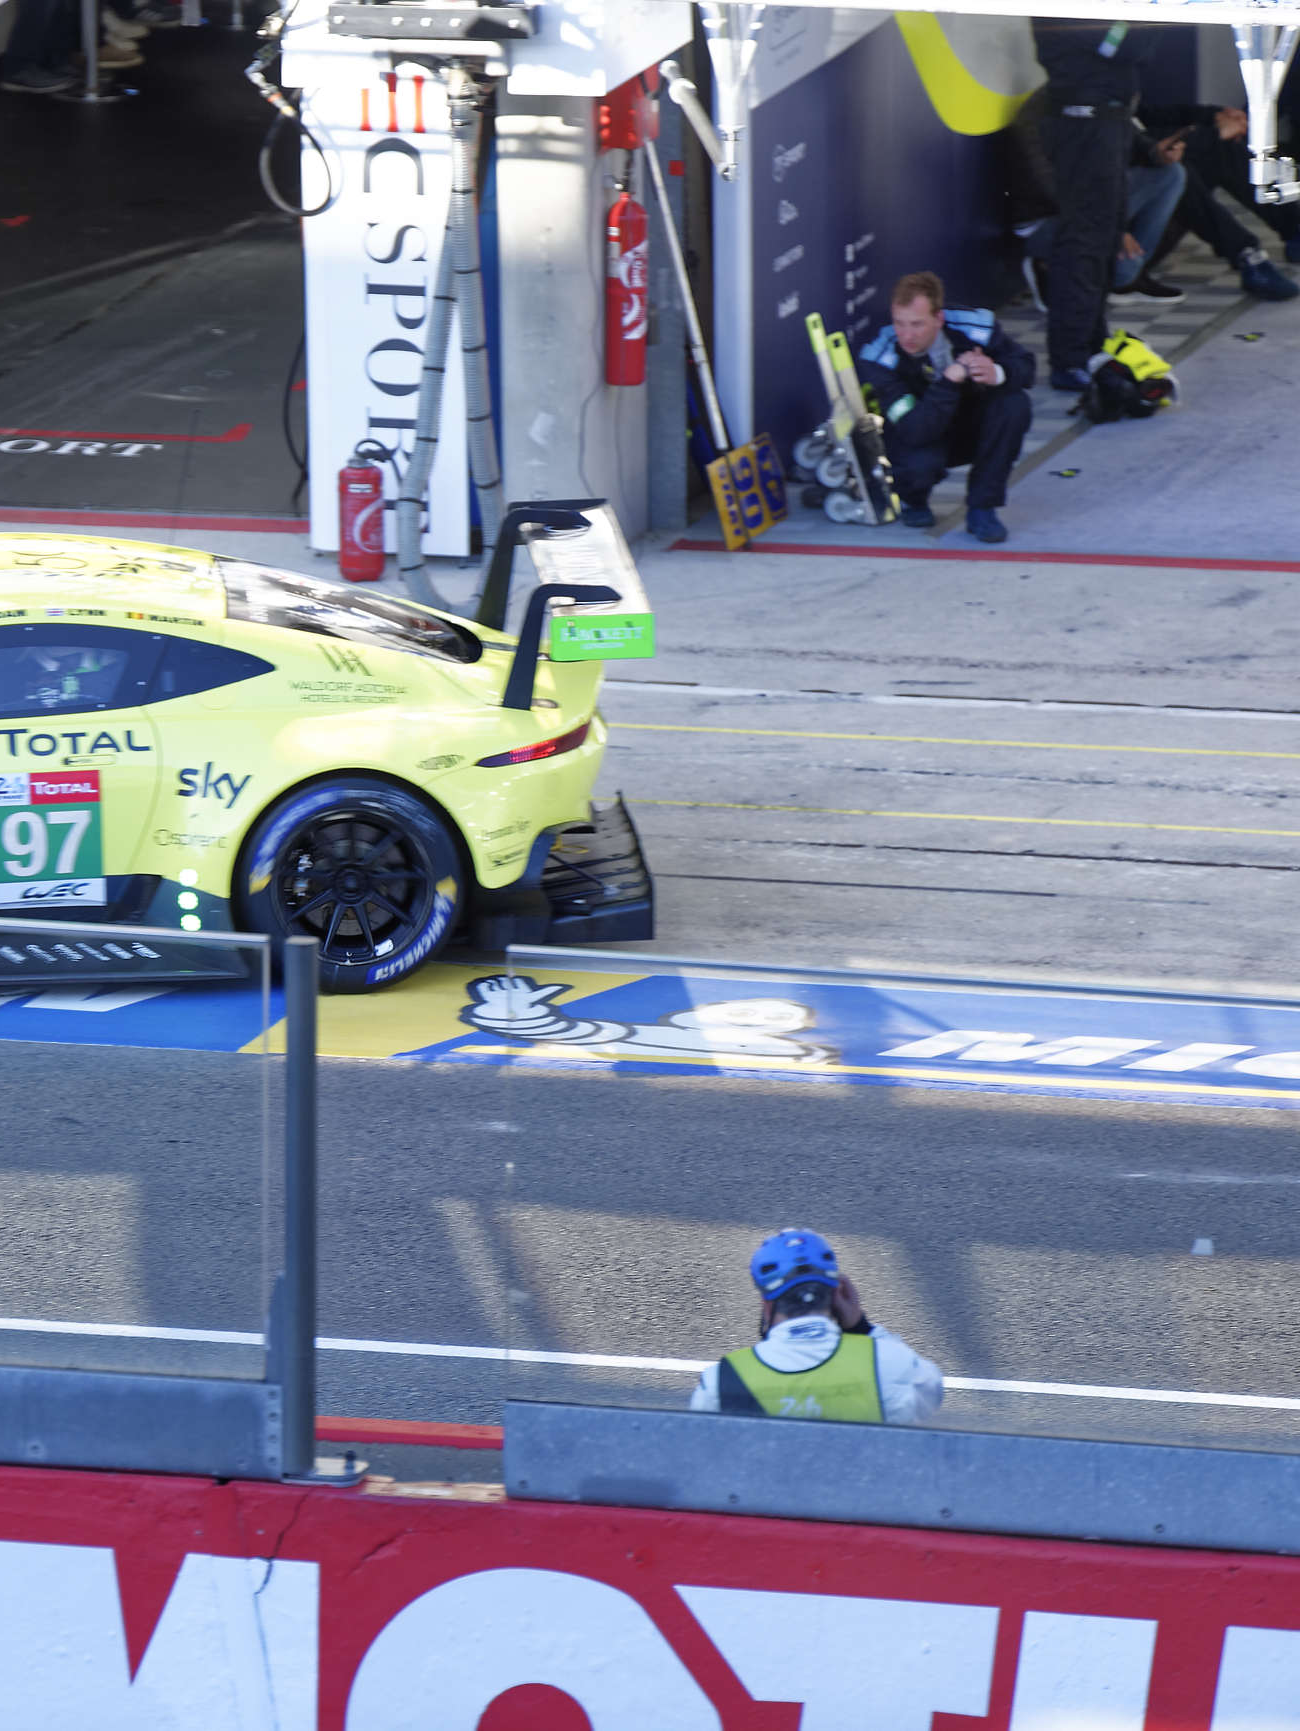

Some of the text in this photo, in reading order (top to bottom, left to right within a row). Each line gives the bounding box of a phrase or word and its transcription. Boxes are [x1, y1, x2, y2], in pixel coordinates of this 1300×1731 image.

[30, 781, 99, 796] TOTAL
[176, 761, 253, 809] sky
[1, 810, 92, 878] 97
